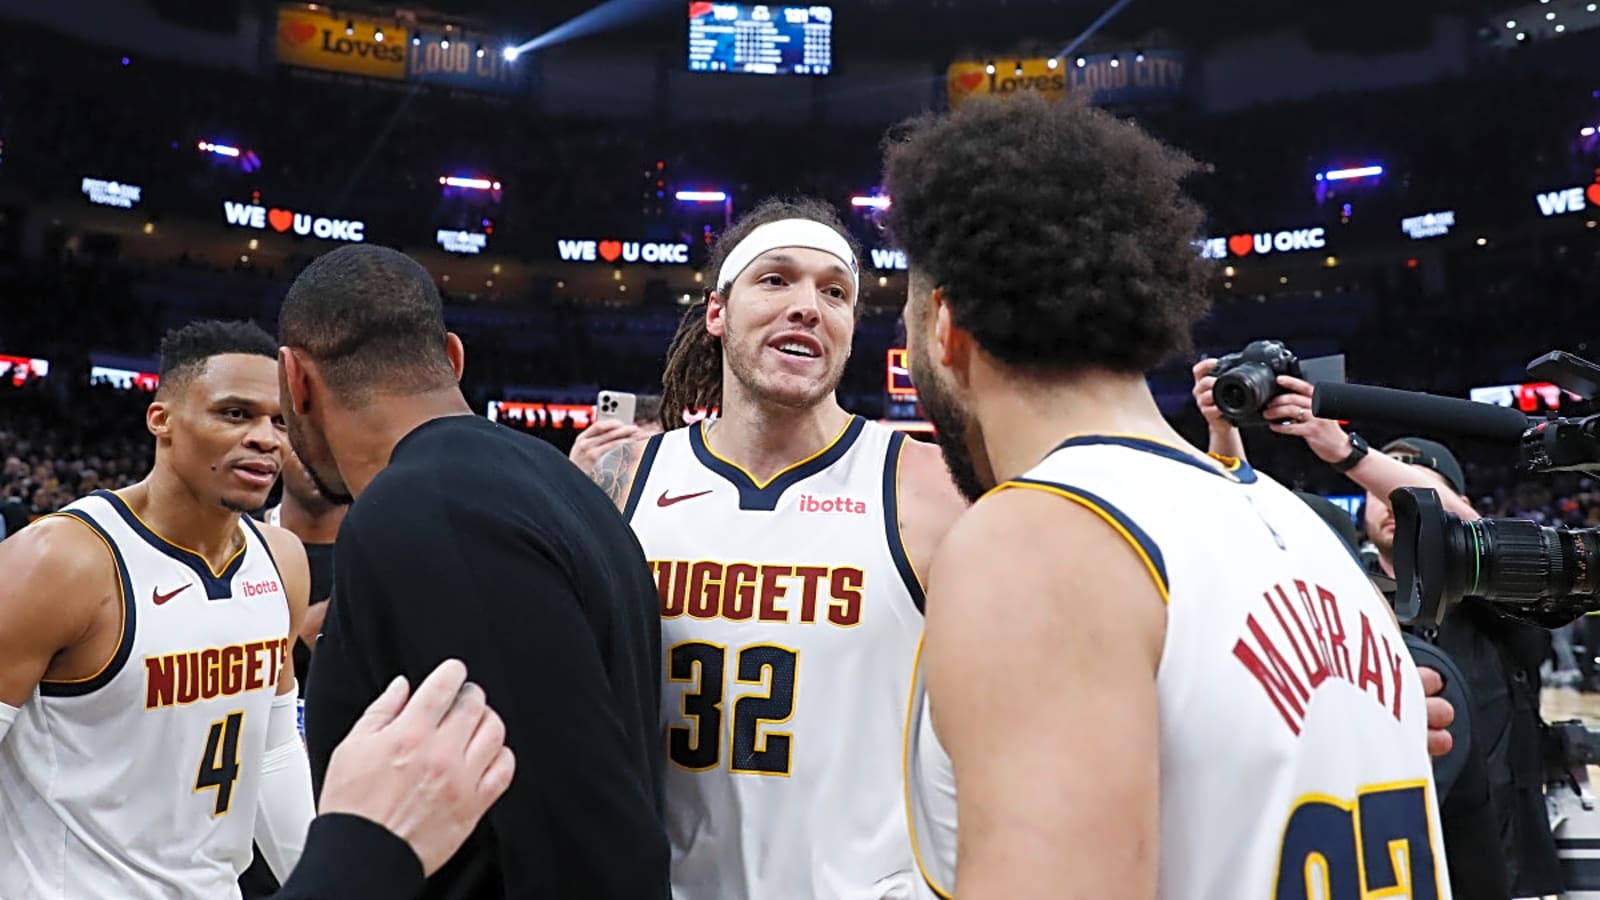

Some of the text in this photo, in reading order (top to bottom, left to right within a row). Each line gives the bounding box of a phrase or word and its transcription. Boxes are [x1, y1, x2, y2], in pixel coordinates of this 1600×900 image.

[1536, 187, 1586, 215] WE
[224, 201, 364, 242] WE U OKC
[558, 240, 689, 263] WE U OKC
[1253, 233, 1272, 254] U
[1274, 227, 1326, 252] OKC
[799, 494, 867, 514] ibotta
[241, 579, 279, 598] ibotta
[646, 560, 865, 628] UGGETS
[666, 639, 800, 777] 32
[192, 710, 245, 818] 4
